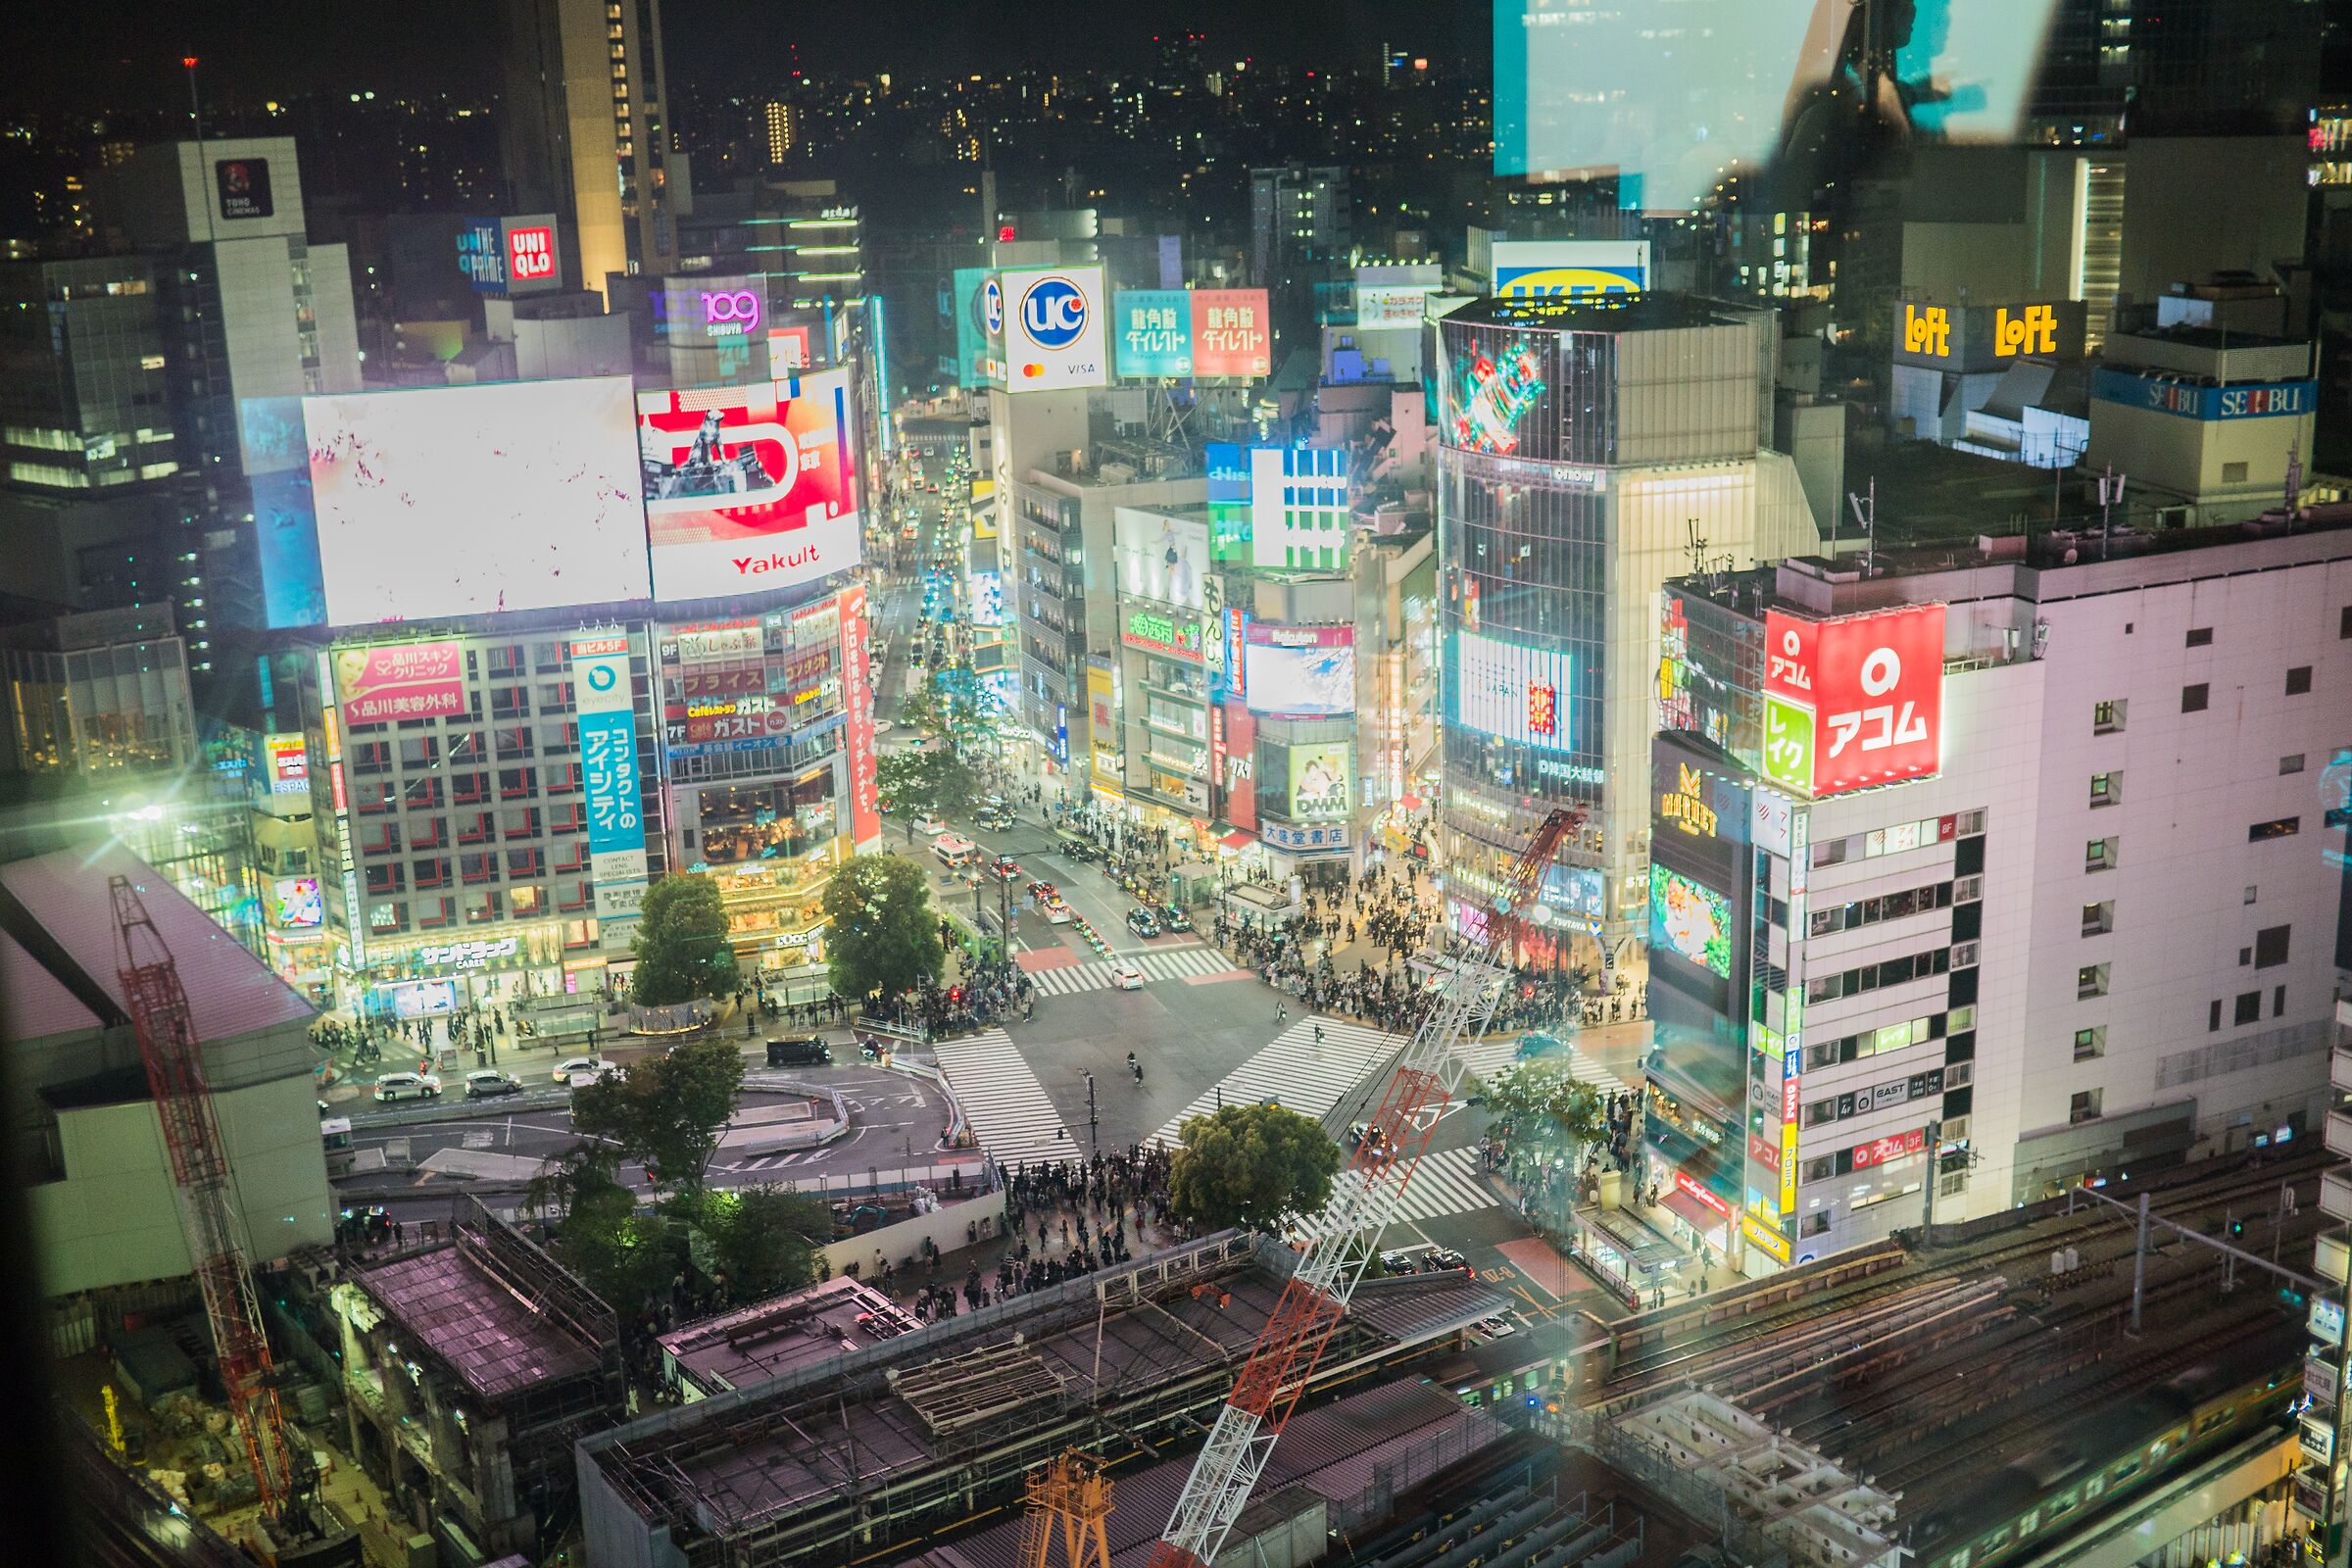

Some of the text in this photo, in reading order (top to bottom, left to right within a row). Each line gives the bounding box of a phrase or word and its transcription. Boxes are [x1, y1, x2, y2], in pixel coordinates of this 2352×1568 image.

[475, 226, 496, 255] THE
[513, 231, 546, 254] UNI
[514, 252, 551, 277] QLO
[701, 289, 760, 334] 109
[988, 293, 1003, 321] UC
[1027, 294, 1083, 331] UC
[1131, 307, 1178, 330] 龍角散
[1206, 306, 1254, 329] 龍角散
[707, 322, 742, 337] SHIBUYA
[1067, 364, 1095, 374] VISA
[2149, 383, 2198, 416] SEIBU
[2220, 387, 2300, 416] SEIBU
[730, 544, 821, 575] Yakult
[1202, 575, 1225, 671] もんじゃ
[392, 648, 454, 667] 品川スキン
[661, 644, 678, 658] 9F
[393, 662, 448, 679] クリニック
[1770, 655, 1812, 690] アコム
[361, 691, 459, 718] 品川美容外科
[582, 693, 625, 706] eyecity
[735, 696, 776, 716] ガスト
[666, 725, 686, 739] 7F
[713, 717, 760, 738] ガスト
[1827, 700, 1929, 760] アコム
[584, 729, 617, 831] アイシティ
[612, 727, 637, 829] コンタクトの
[1296, 796, 1348, 813] DMM
[1941, 822, 1953, 834] 8F
[599, 868, 642, 878] SPECIALISTS
[1552, 916, 1587, 931] TSUTAYA
[420, 938, 517, 965] サンドラッグ
[1908, 1135, 1921, 1149] 3F
